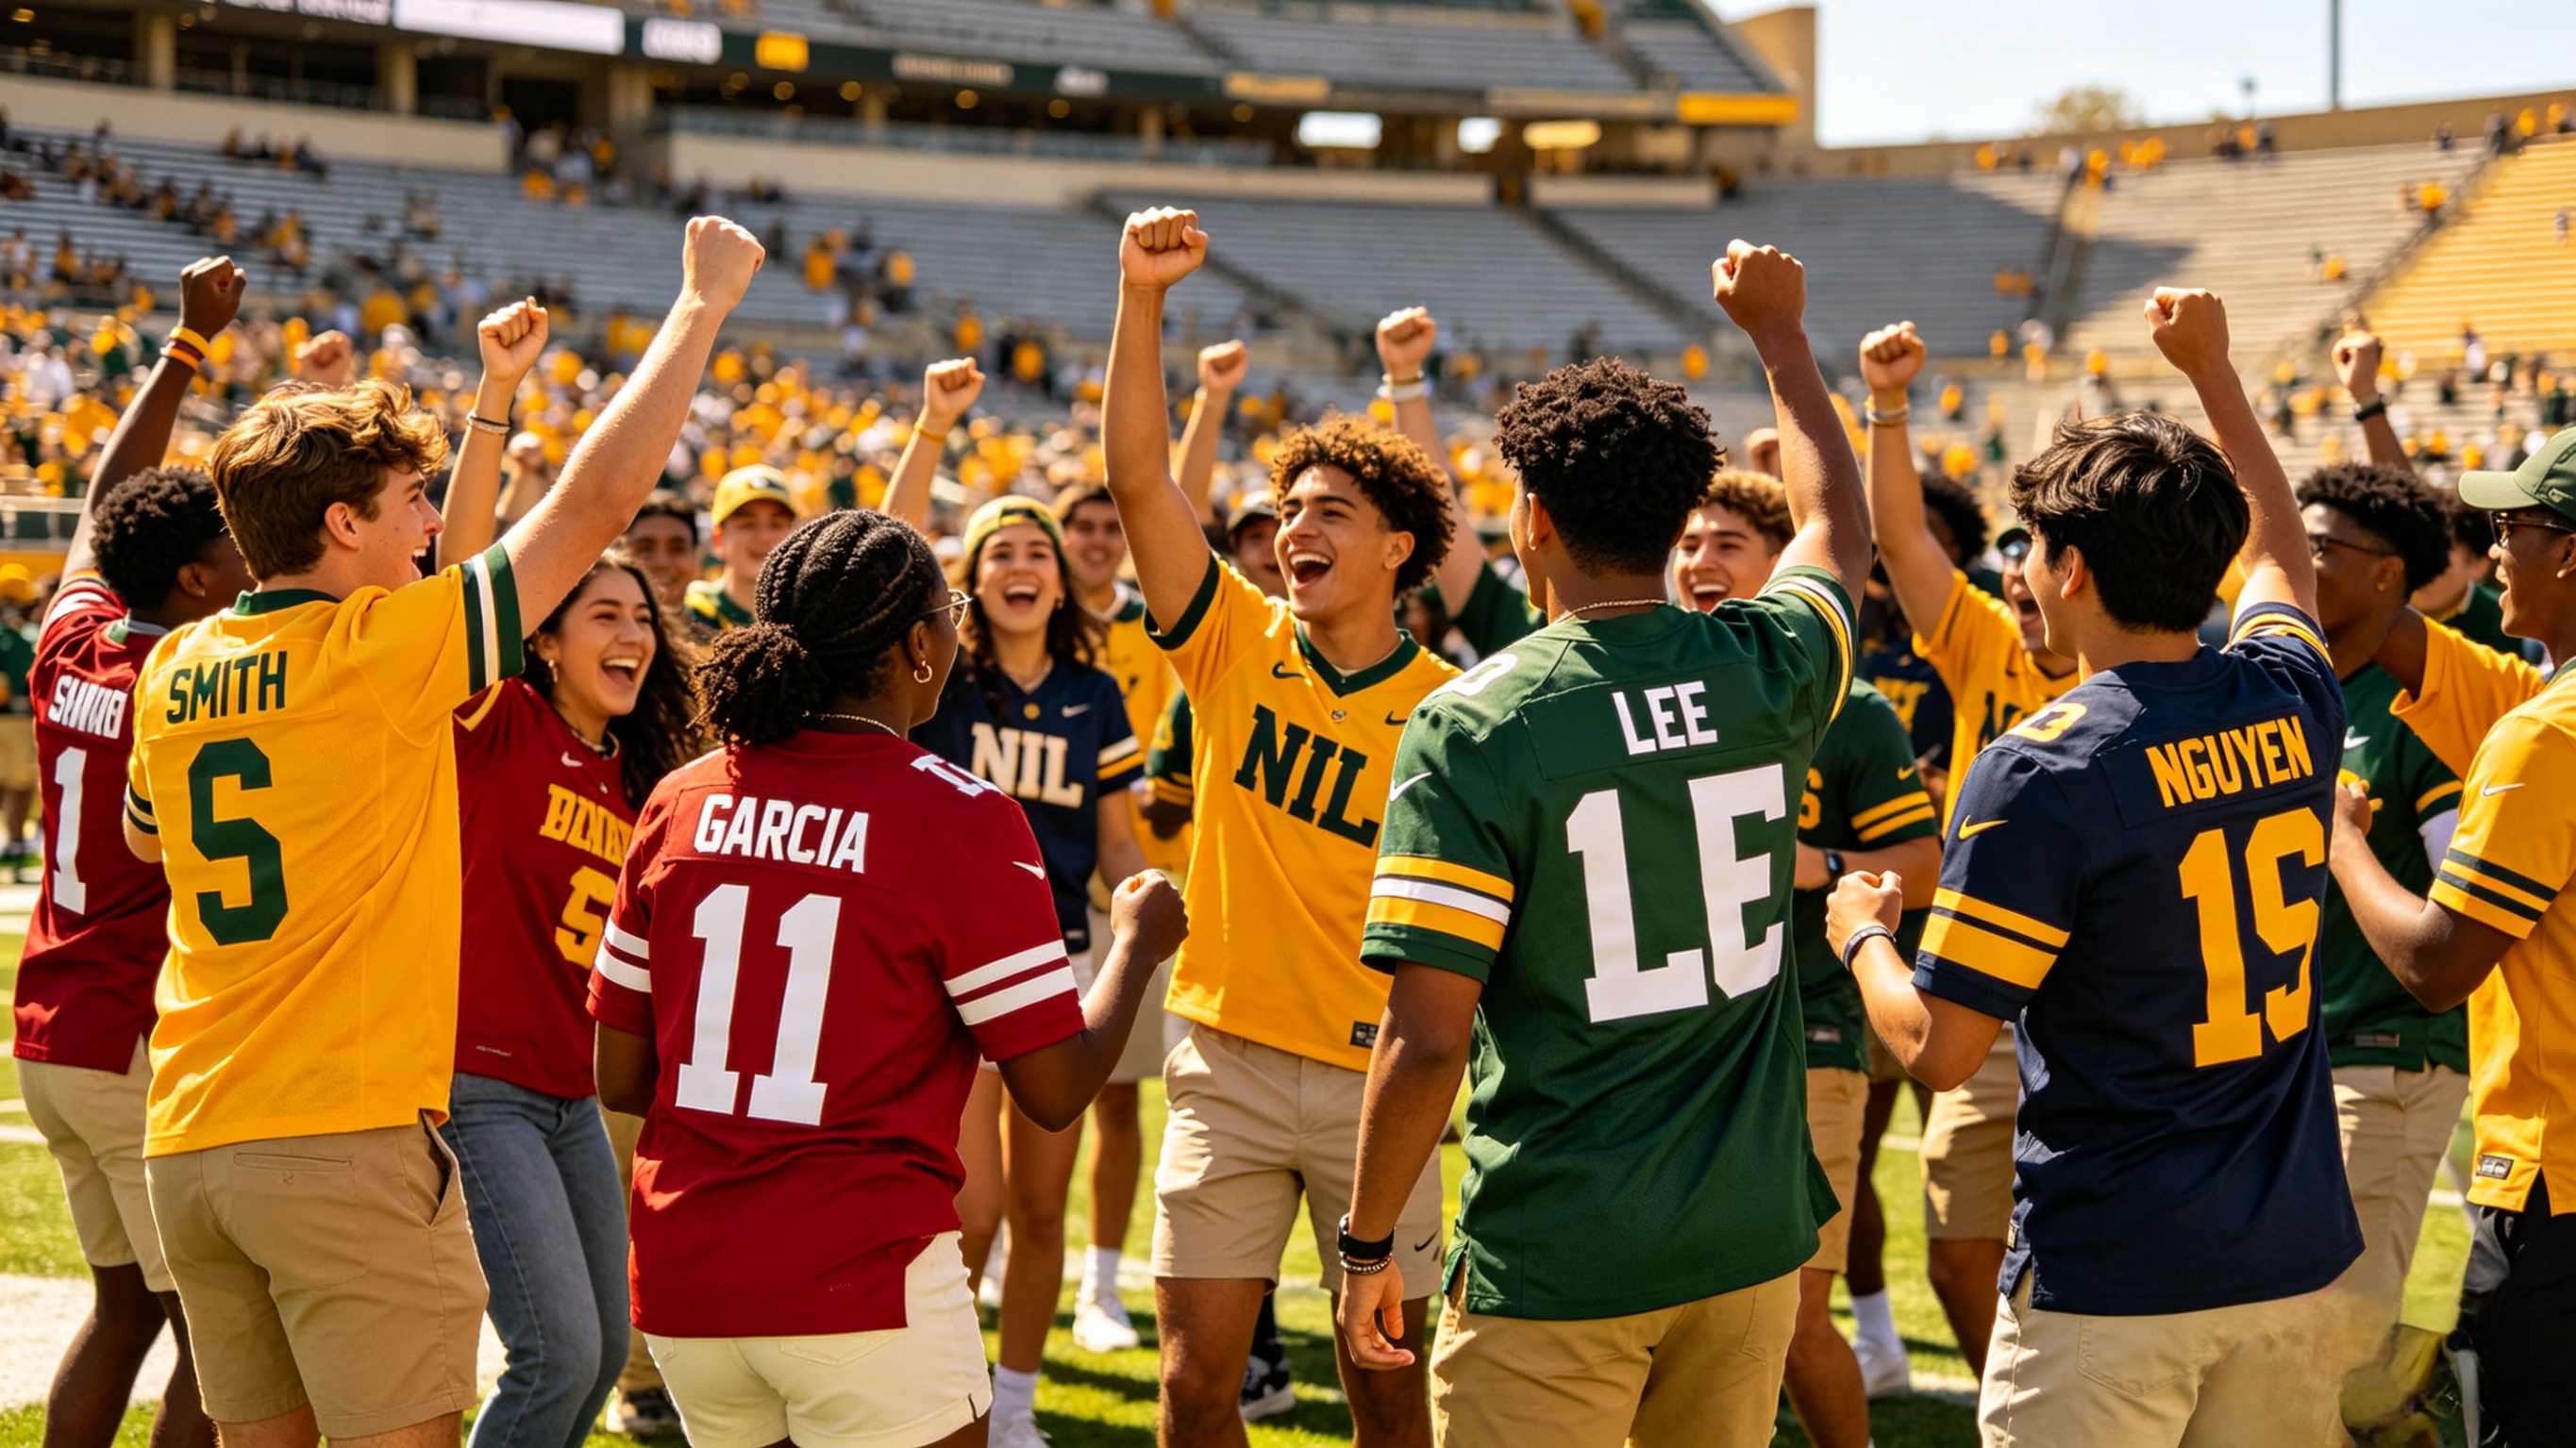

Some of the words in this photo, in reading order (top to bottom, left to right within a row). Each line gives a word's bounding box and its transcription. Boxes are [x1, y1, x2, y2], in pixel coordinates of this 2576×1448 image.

[166, 651, 287, 724] SMITH
[1613, 680, 1717, 757] LEE
[971, 722, 1084, 808] NIL
[1233, 704, 1379, 848] NIL
[2146, 715, 2314, 808] NGUYEN
[53, 746, 88, 916] 1
[694, 793, 870, 874] GARCIA
[675, 884, 842, 1126] 11
